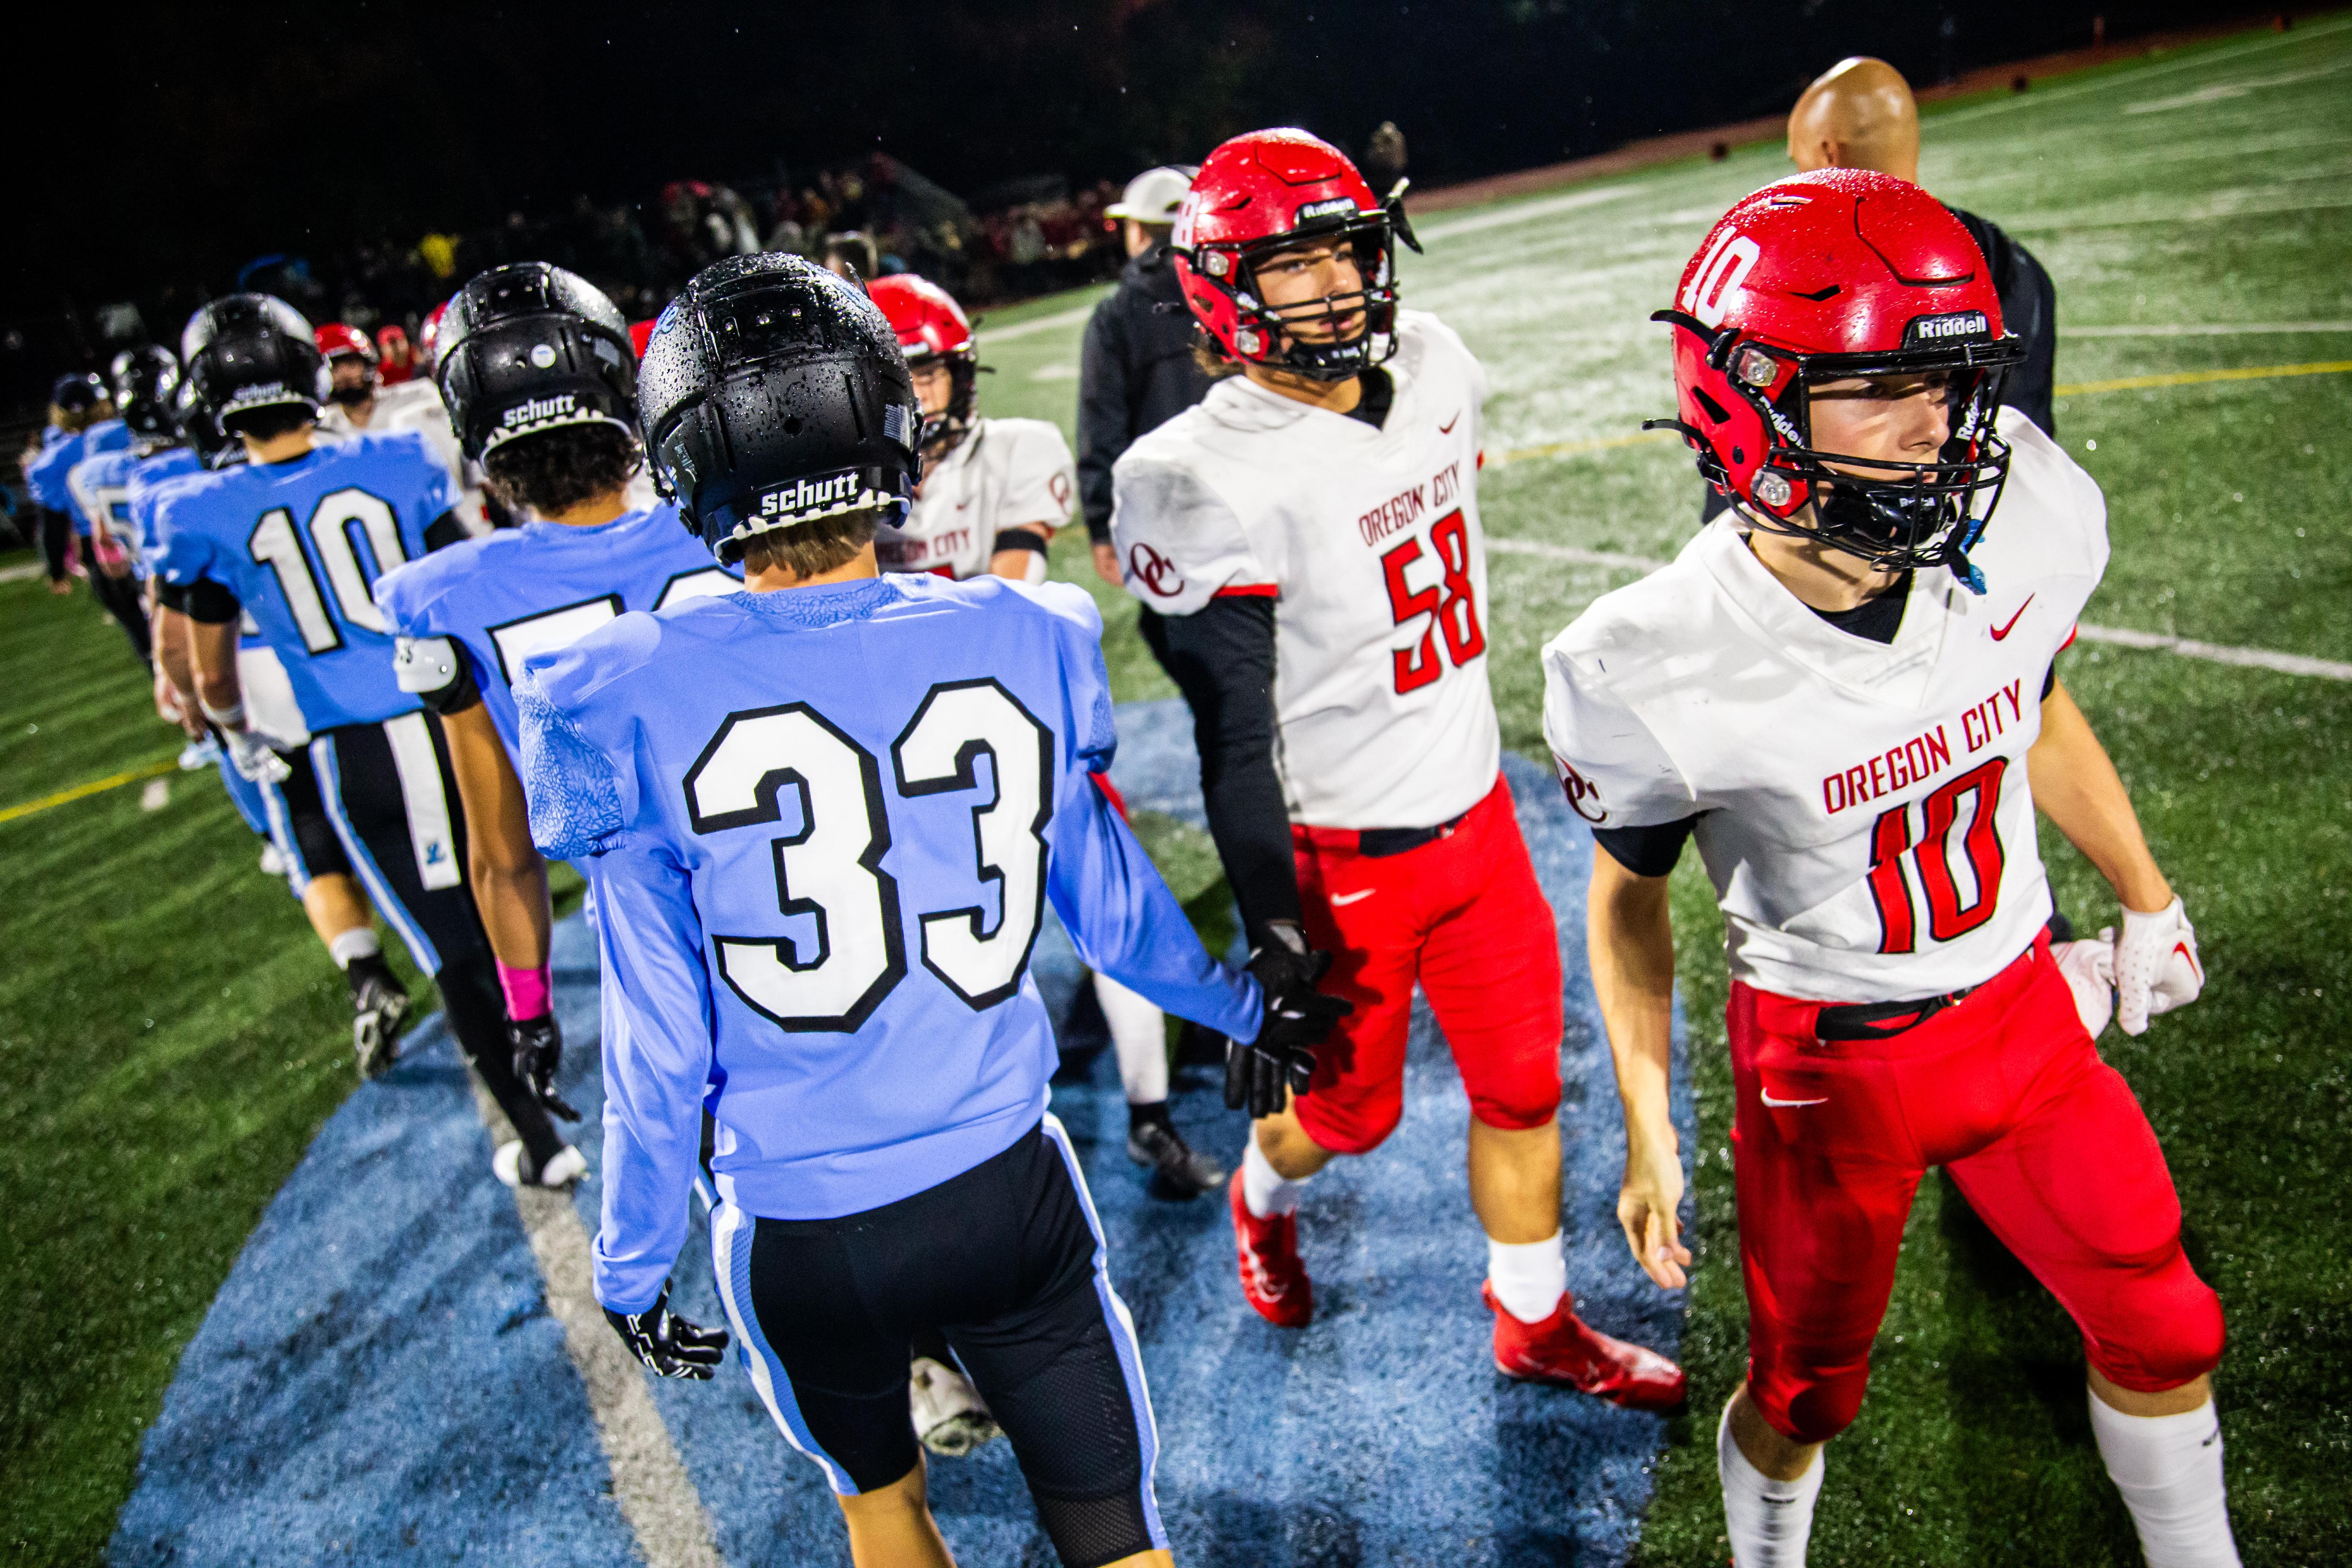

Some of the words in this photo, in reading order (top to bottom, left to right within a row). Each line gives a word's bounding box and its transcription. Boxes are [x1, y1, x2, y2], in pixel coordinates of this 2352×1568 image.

[1681, 225, 1761, 329] 10
[1918, 316, 1987, 338] Riddell
[504, 395, 575, 427] schutt
[763, 473, 858, 515] schutt
[1358, 484, 1424, 547] OREGON
[1433, 461, 1460, 508] CITY
[248, 485, 406, 656] 10
[1130, 542, 1184, 597] OC
[1381, 508, 1485, 695] 58
[1822, 725, 1950, 815] OREGON
[1961, 679, 2022, 753] CITY
[683, 676, 1054, 1033] 33
[1867, 755, 2008, 955] 10
